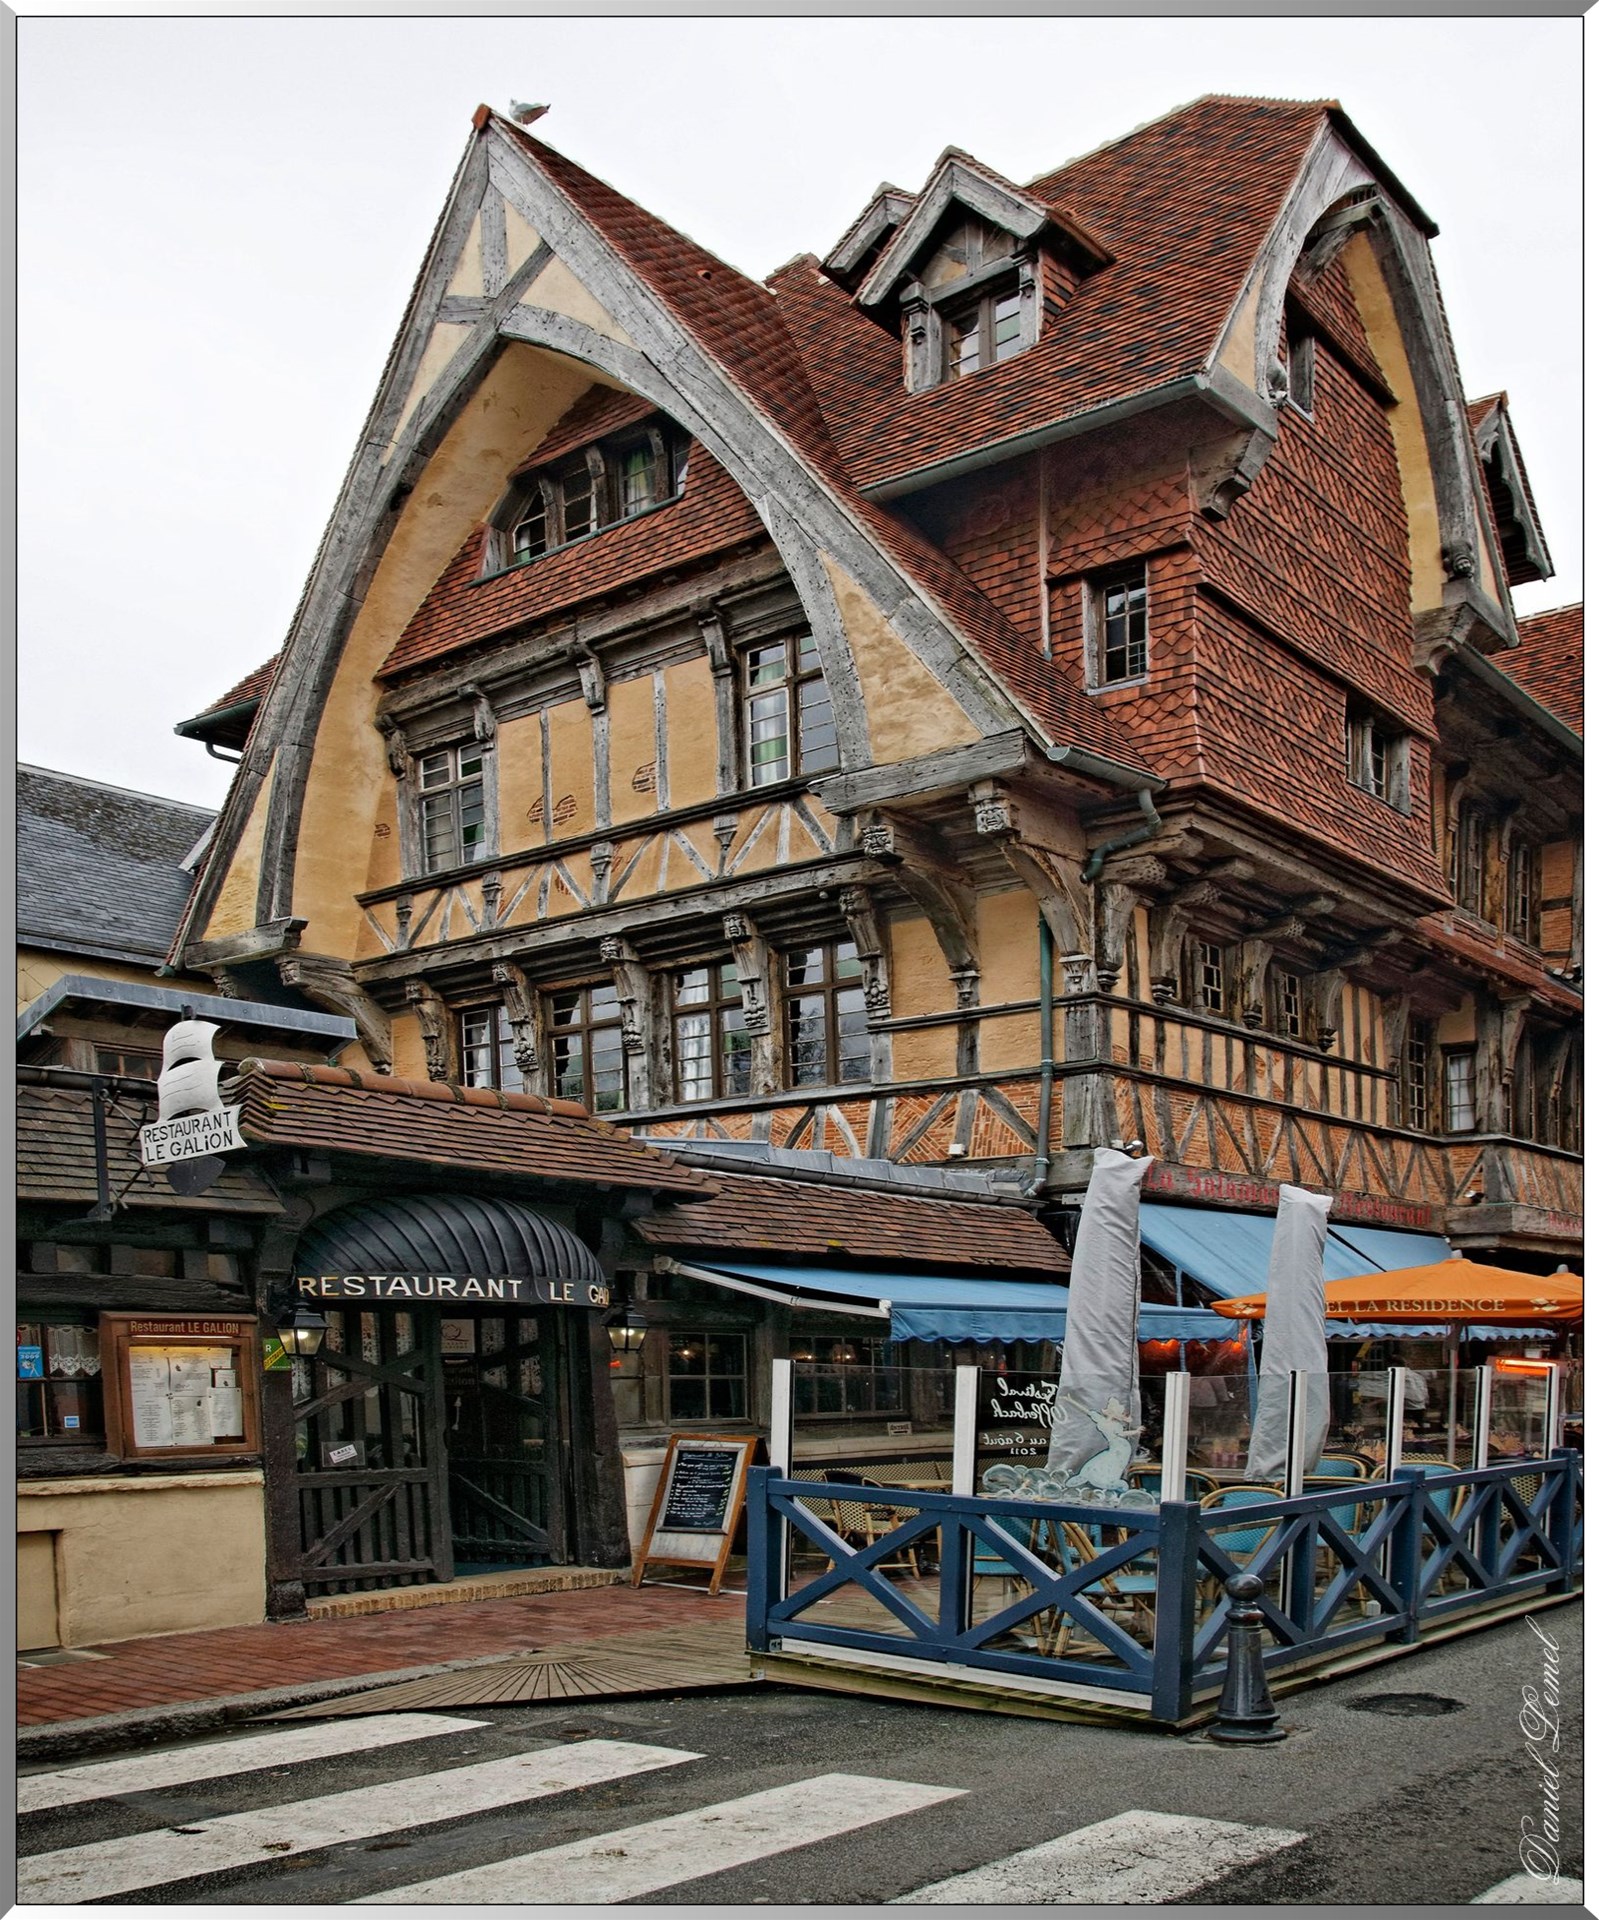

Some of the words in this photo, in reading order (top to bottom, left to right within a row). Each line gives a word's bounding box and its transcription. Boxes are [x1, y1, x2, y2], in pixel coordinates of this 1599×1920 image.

[144, 1111, 231, 1144] RESTAURANT
[145, 1144, 166, 1162] LE
[297, 1275, 523, 1299] RESTAURANT
[548, 1281, 575, 1302] LE
[1354, 1300, 1380, 1313] LA
[1385, 1299, 1506, 1313] RESIDENCE
[130, 1320, 185, 1333] Restaurant
[187, 1321, 200, 1333] LE
[202, 1322, 239, 1334] GALION
